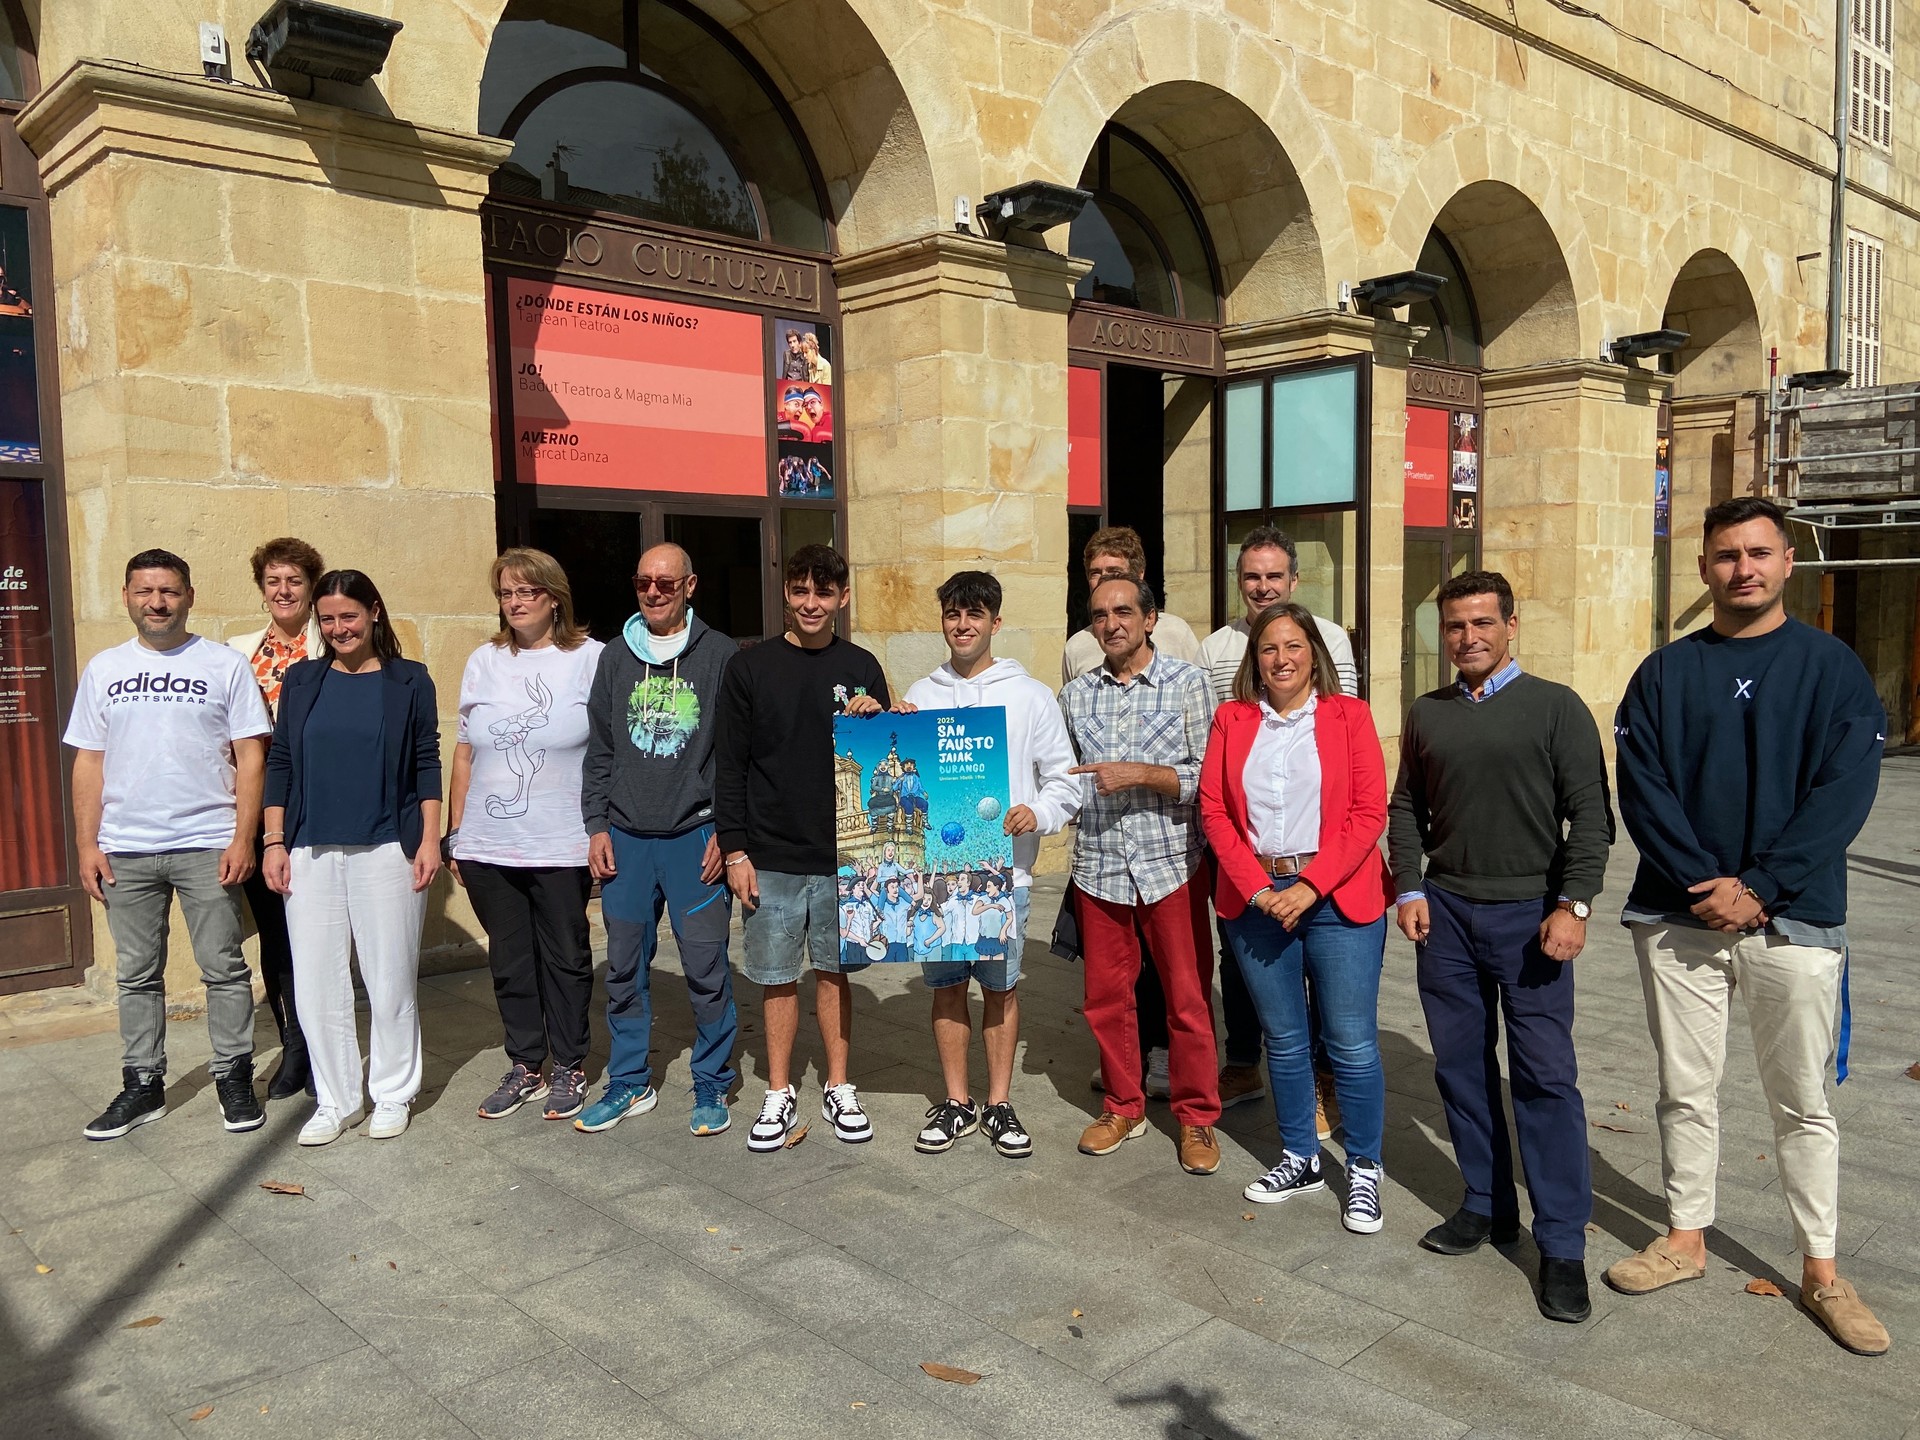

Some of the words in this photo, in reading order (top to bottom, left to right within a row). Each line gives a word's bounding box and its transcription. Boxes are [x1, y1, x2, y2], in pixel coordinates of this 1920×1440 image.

[480, 213, 603, 266] PACIO
[632, 241, 813, 301] CULTURAL
[515, 292, 574, 312] ¿DÓNDE
[577, 299, 621, 319] ESTÁN
[623, 308, 649, 323] LOS
[652, 311, 699, 330] NIÑOS?
[517, 308, 568, 327] Tartean
[571, 315, 620, 334] Teatroa
[1091, 319, 1191, 358] AGUSTIN
[517, 362, 543, 377] JO!
[519, 377, 559, 394] Badut
[561, 381, 611, 399] Teatroa
[613, 387, 623, 400] &
[625, 388, 670, 406] Magma
[672, 393, 693, 407] Mia
[1411, 371, 1467, 400] GUNEA
[520, 430, 579, 446] AVERNO
[522, 445, 567, 461] Marcat
[570, 448, 609, 463] Danza
[3, 565, 24, 578] de
[107, 671, 208, 698] adidas
[937, 724, 965, 738] SAN
[937, 735, 994, 751] FAUSTO
[938, 751, 974, 763] JAIAK
[939, 763, 985, 774] DURANGO
